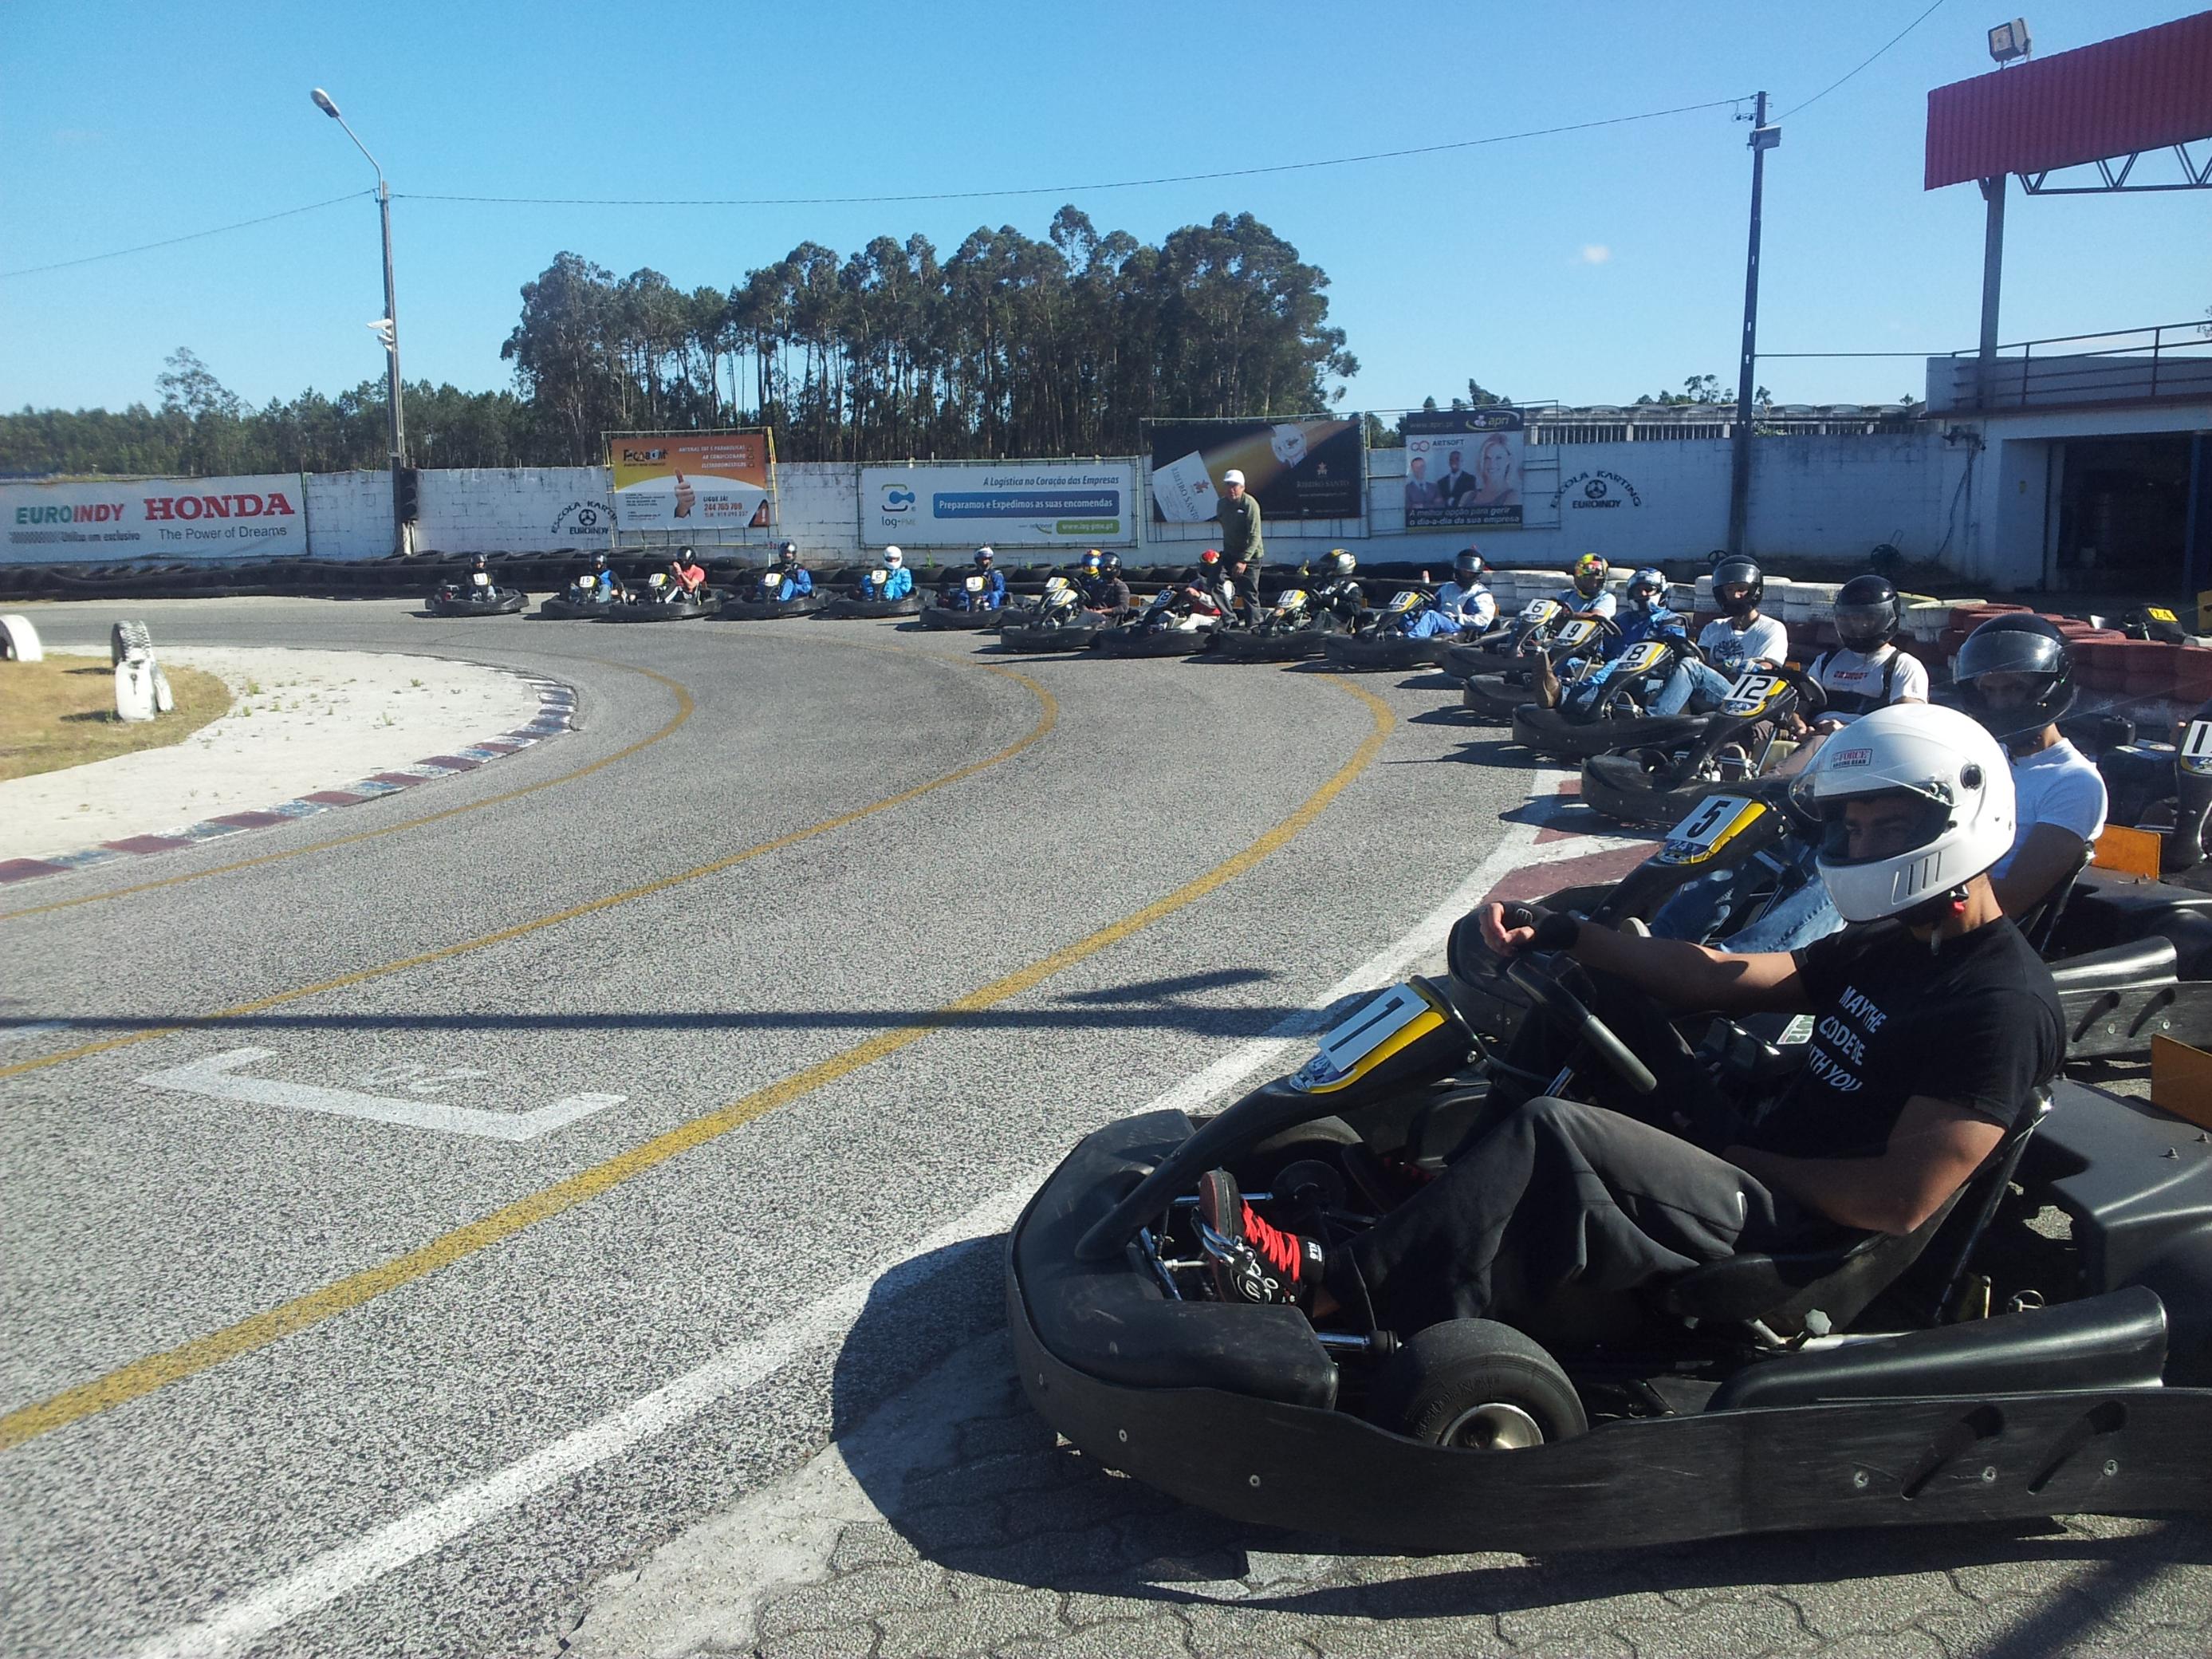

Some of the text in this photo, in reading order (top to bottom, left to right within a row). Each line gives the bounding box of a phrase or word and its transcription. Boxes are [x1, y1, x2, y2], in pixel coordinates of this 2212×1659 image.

[1488, 416, 1509, 428] apri
[983, 477, 989, 486] A
[990, 476, 1023, 488] Logística
[1036, 476, 1065, 487] Coração
[1067, 476, 1080, 485] das
[1082, 475, 1119, 487] Empresas
[1596, 471, 1642, 506] KARTING
[144, 492, 295, 520] HONDA
[939, 500, 985, 511] Preparamos
[992, 499, 1034, 510] Expedimos
[1064, 498, 1113, 508] encomendas
[1572, 499, 1622, 509] EUROINDY
[16, 504, 124, 524] EUROINDY
[552, 501, 581, 534] ESCOLA
[159, 525, 288, 540] The Power of Dreams
[1281, 591, 1295, 601] 14
[1393, 592, 1411, 603] 16
[1532, 601, 1546, 613] 6
[1567, 623, 1582, 637] 9
[1627, 644, 1647, 660] 8
[1733, 676, 1771, 699] 12
[2191, 723, 2212, 754] 1
[1687, 800, 1732, 838] 5
[1839, 986, 1887, 1034] MAY THE
[1819, 1015, 1858, 1054] CODE
[1809, 1043, 1864, 1092] ITH YOU
